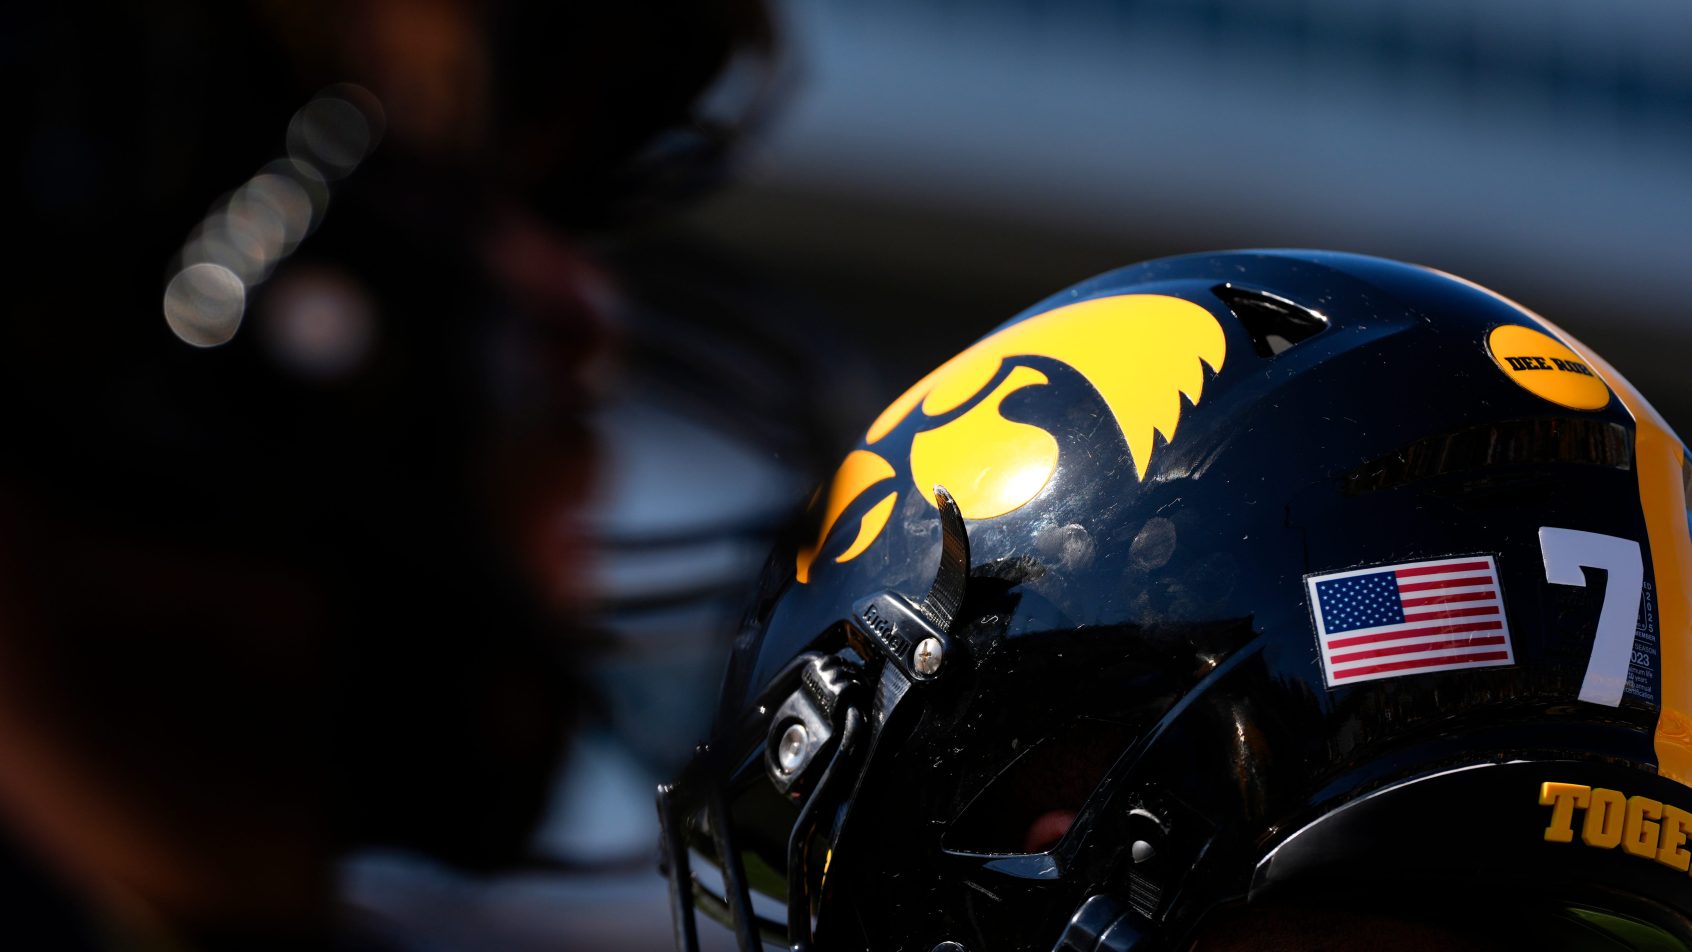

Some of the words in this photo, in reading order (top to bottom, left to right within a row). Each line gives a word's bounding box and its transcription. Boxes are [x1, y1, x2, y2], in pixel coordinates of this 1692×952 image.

[1504, 356, 1553, 371] DEE
[862, 603, 912, 659] Riddell
[1538, 526, 1644, 707] 7
[1630, 650, 1650, 666] 023
[1538, 781, 1692, 877] TOGE
